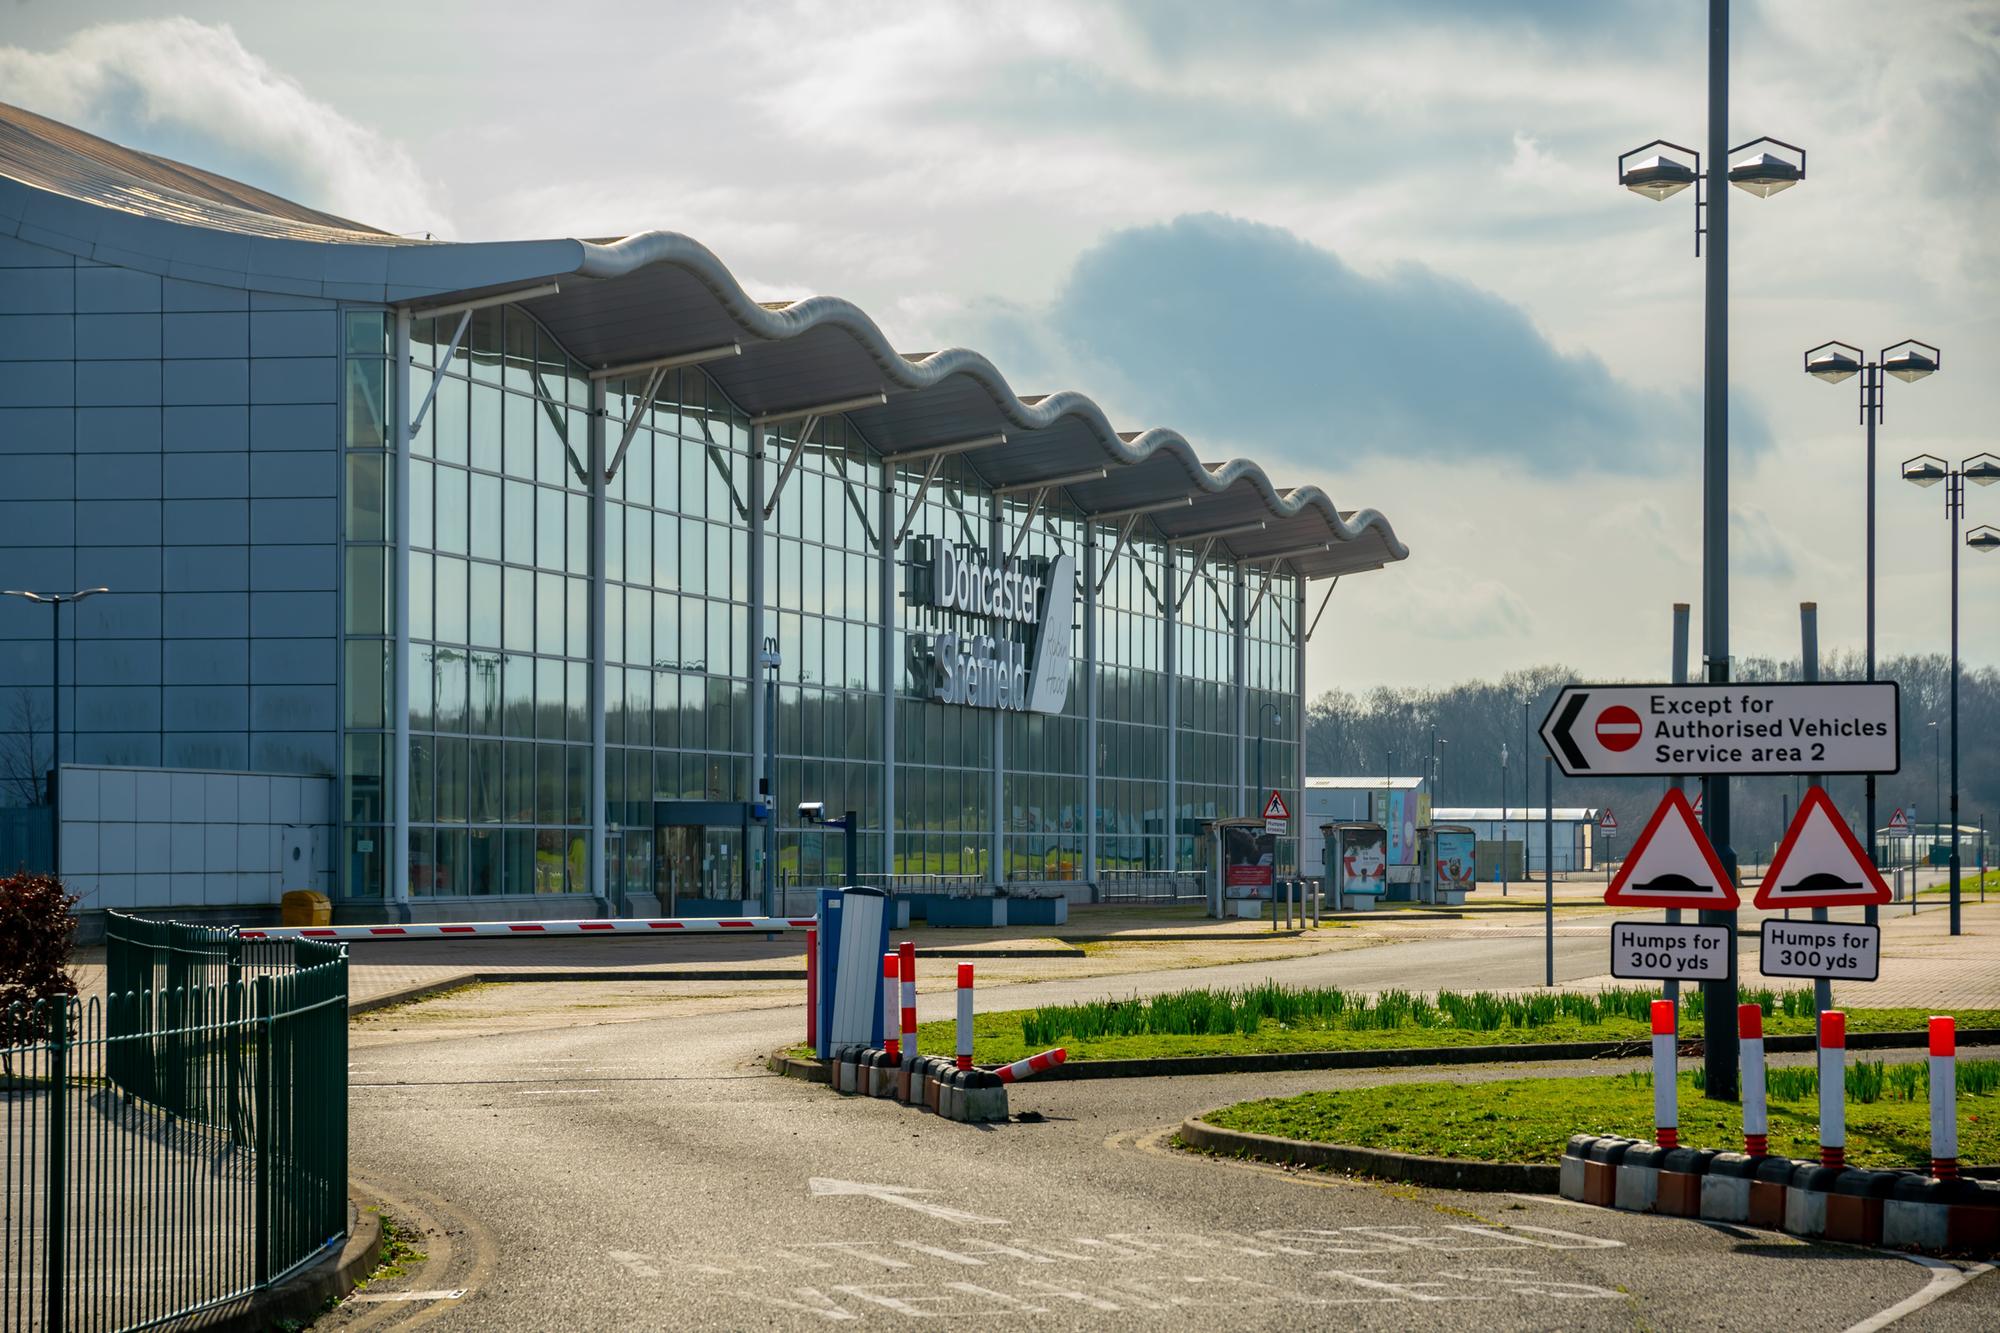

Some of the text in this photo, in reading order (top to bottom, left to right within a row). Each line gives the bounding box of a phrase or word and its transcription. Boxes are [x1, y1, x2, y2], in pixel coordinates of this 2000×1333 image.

[941, 539, 1040, 624] Doncaster
[938, 632, 1025, 711] Sheffield
[1650, 695, 1774, 717] Except for
[1654, 717, 1888, 739] Authorised Vehicles
[1655, 743, 1826, 763] Service area 2
[1621, 932, 1721, 950] Humps for
[1772, 930, 1870, 949] Humps for
[1631, 952, 1709, 972] 300 yds
[1781, 950, 1858, 970] 300 yds
[720, 1267, 1626, 1320] VEHICLES
